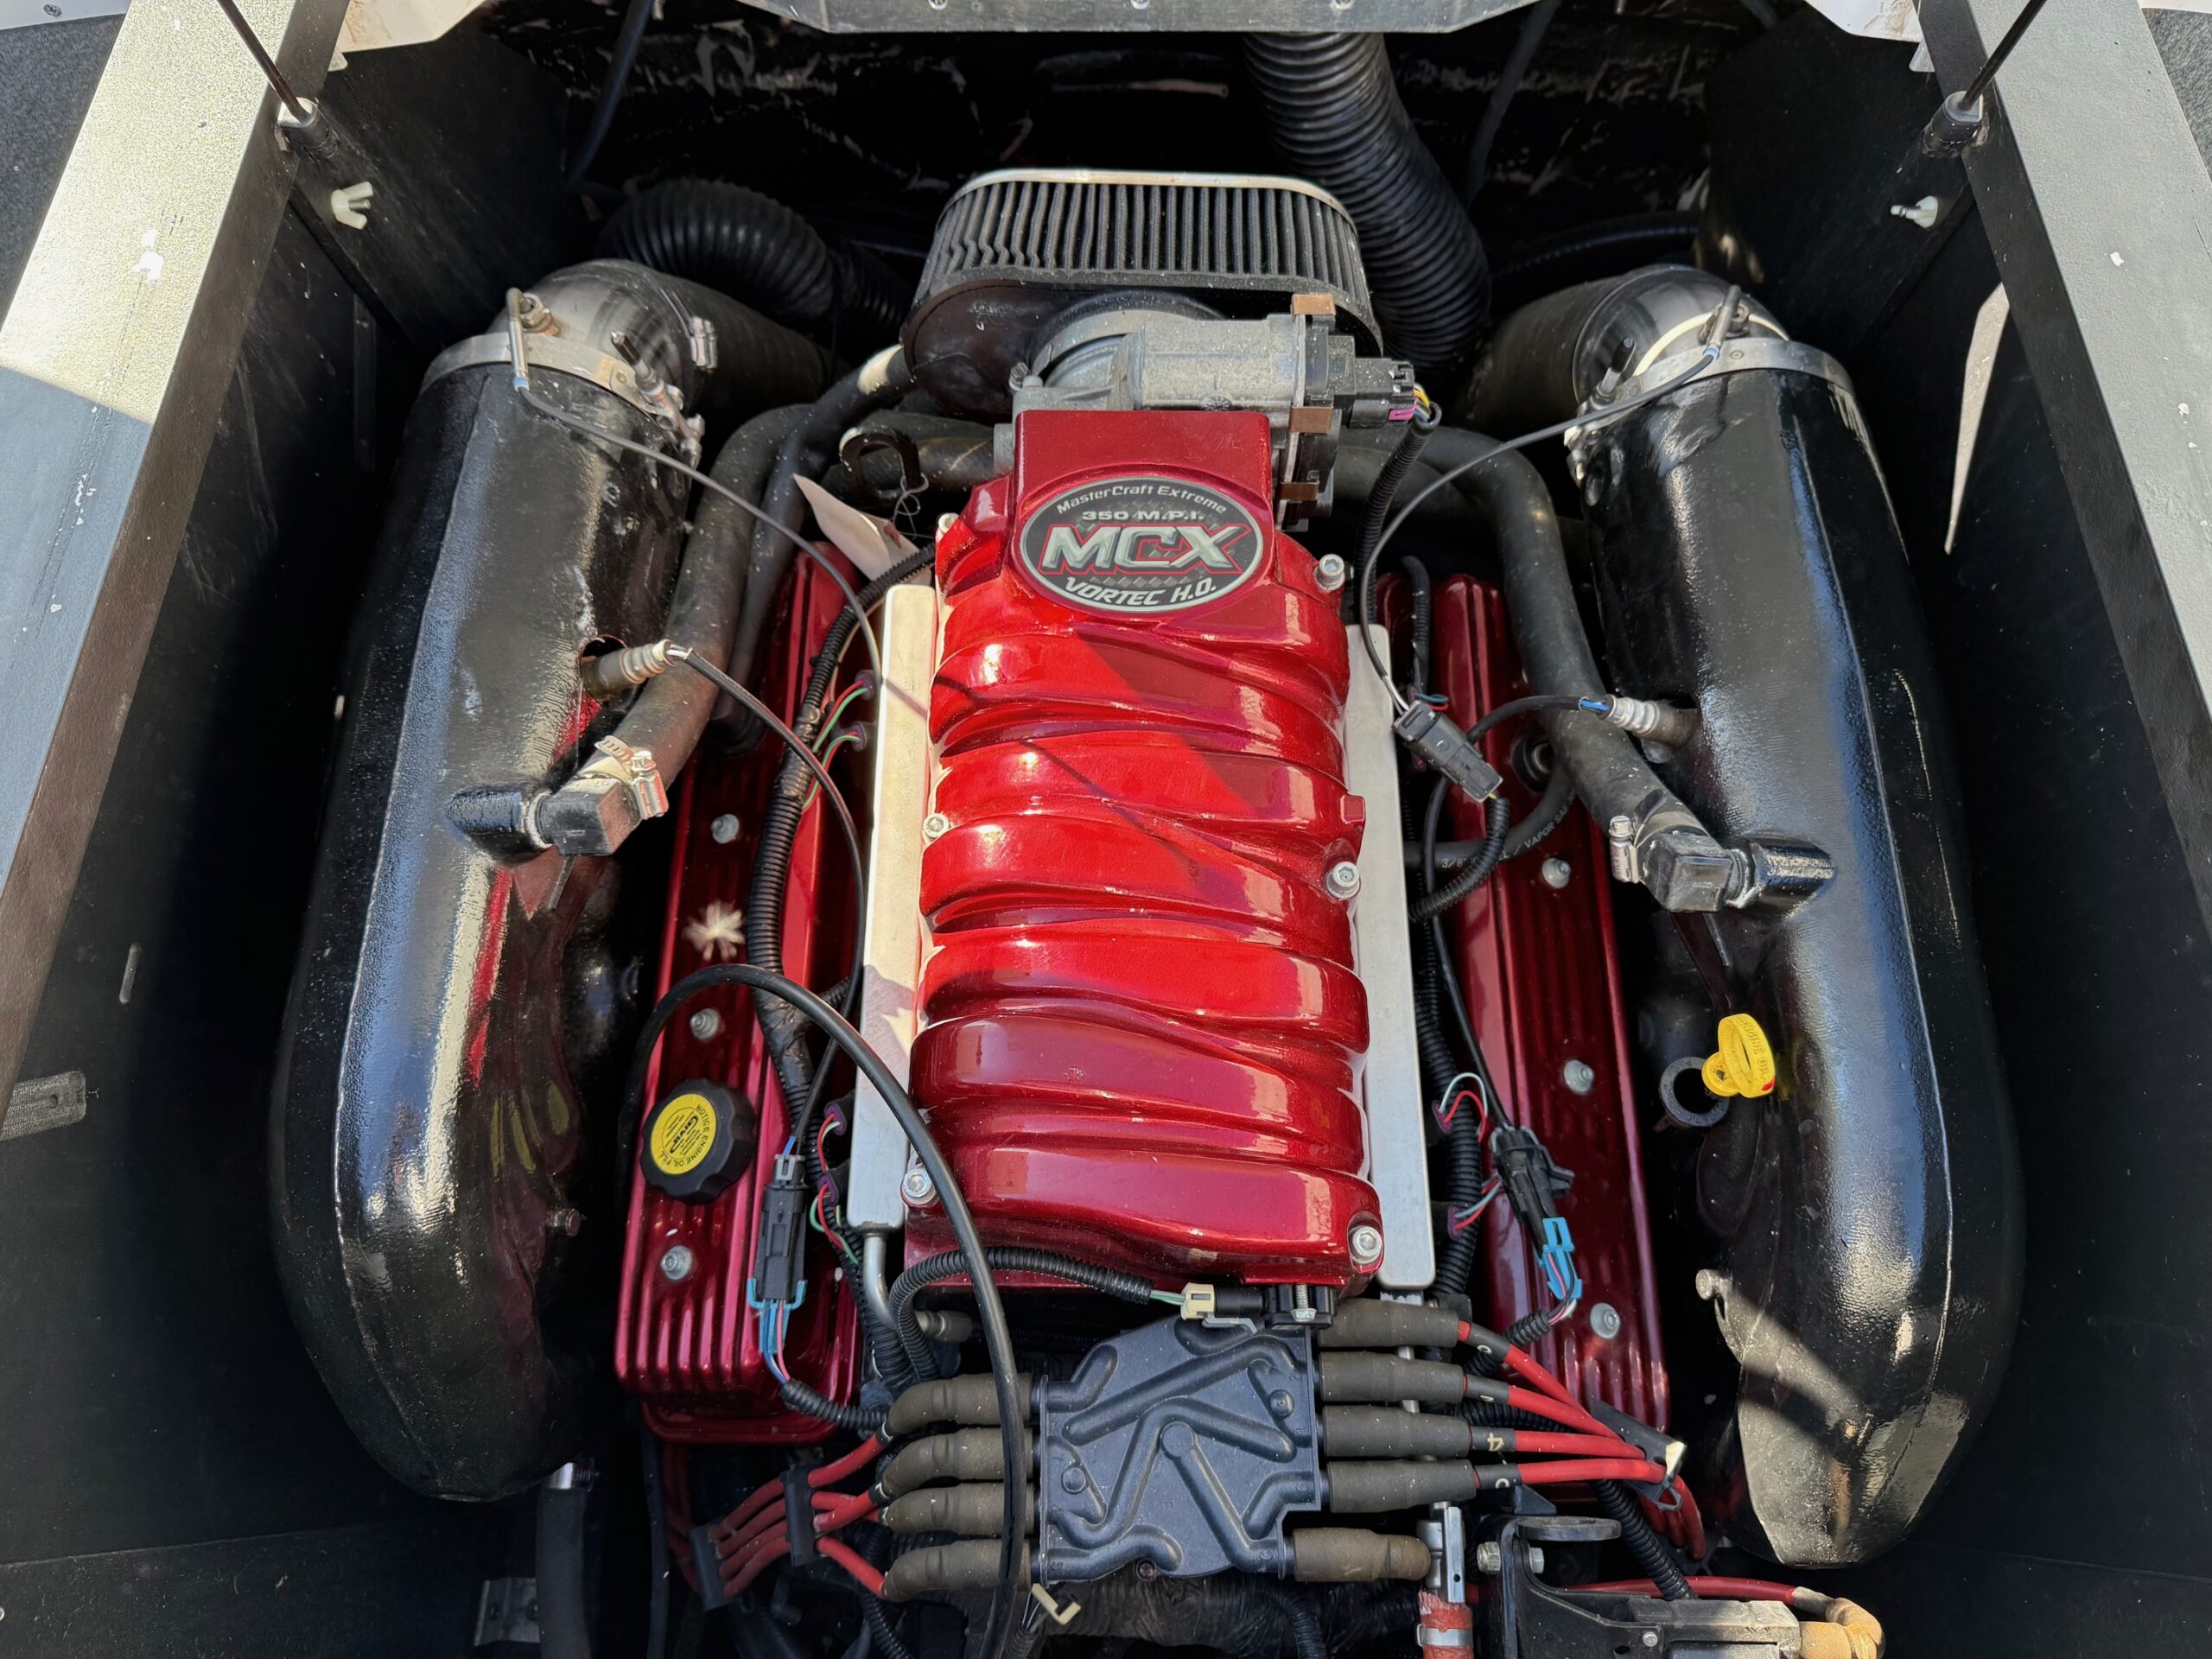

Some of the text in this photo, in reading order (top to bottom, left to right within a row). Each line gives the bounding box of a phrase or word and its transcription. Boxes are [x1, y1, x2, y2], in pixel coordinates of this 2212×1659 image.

[1056, 484, 1227, 514] MasterCraft Extreme
[1082, 511, 1204, 521] 350 M.P.I.
[1040, 524, 1247, 569] MCX
[1065, 575, 1217, 606] VORTEC H.O.
[1523, 822, 1555, 849] VAPOR
[1738, 1020, 1771, 1079] ENGINE OIL
[696, 1103, 710, 1133] NOTICE
[673, 1159, 685, 1167] OIL
[687, 1135, 709, 1164] ENGINE
